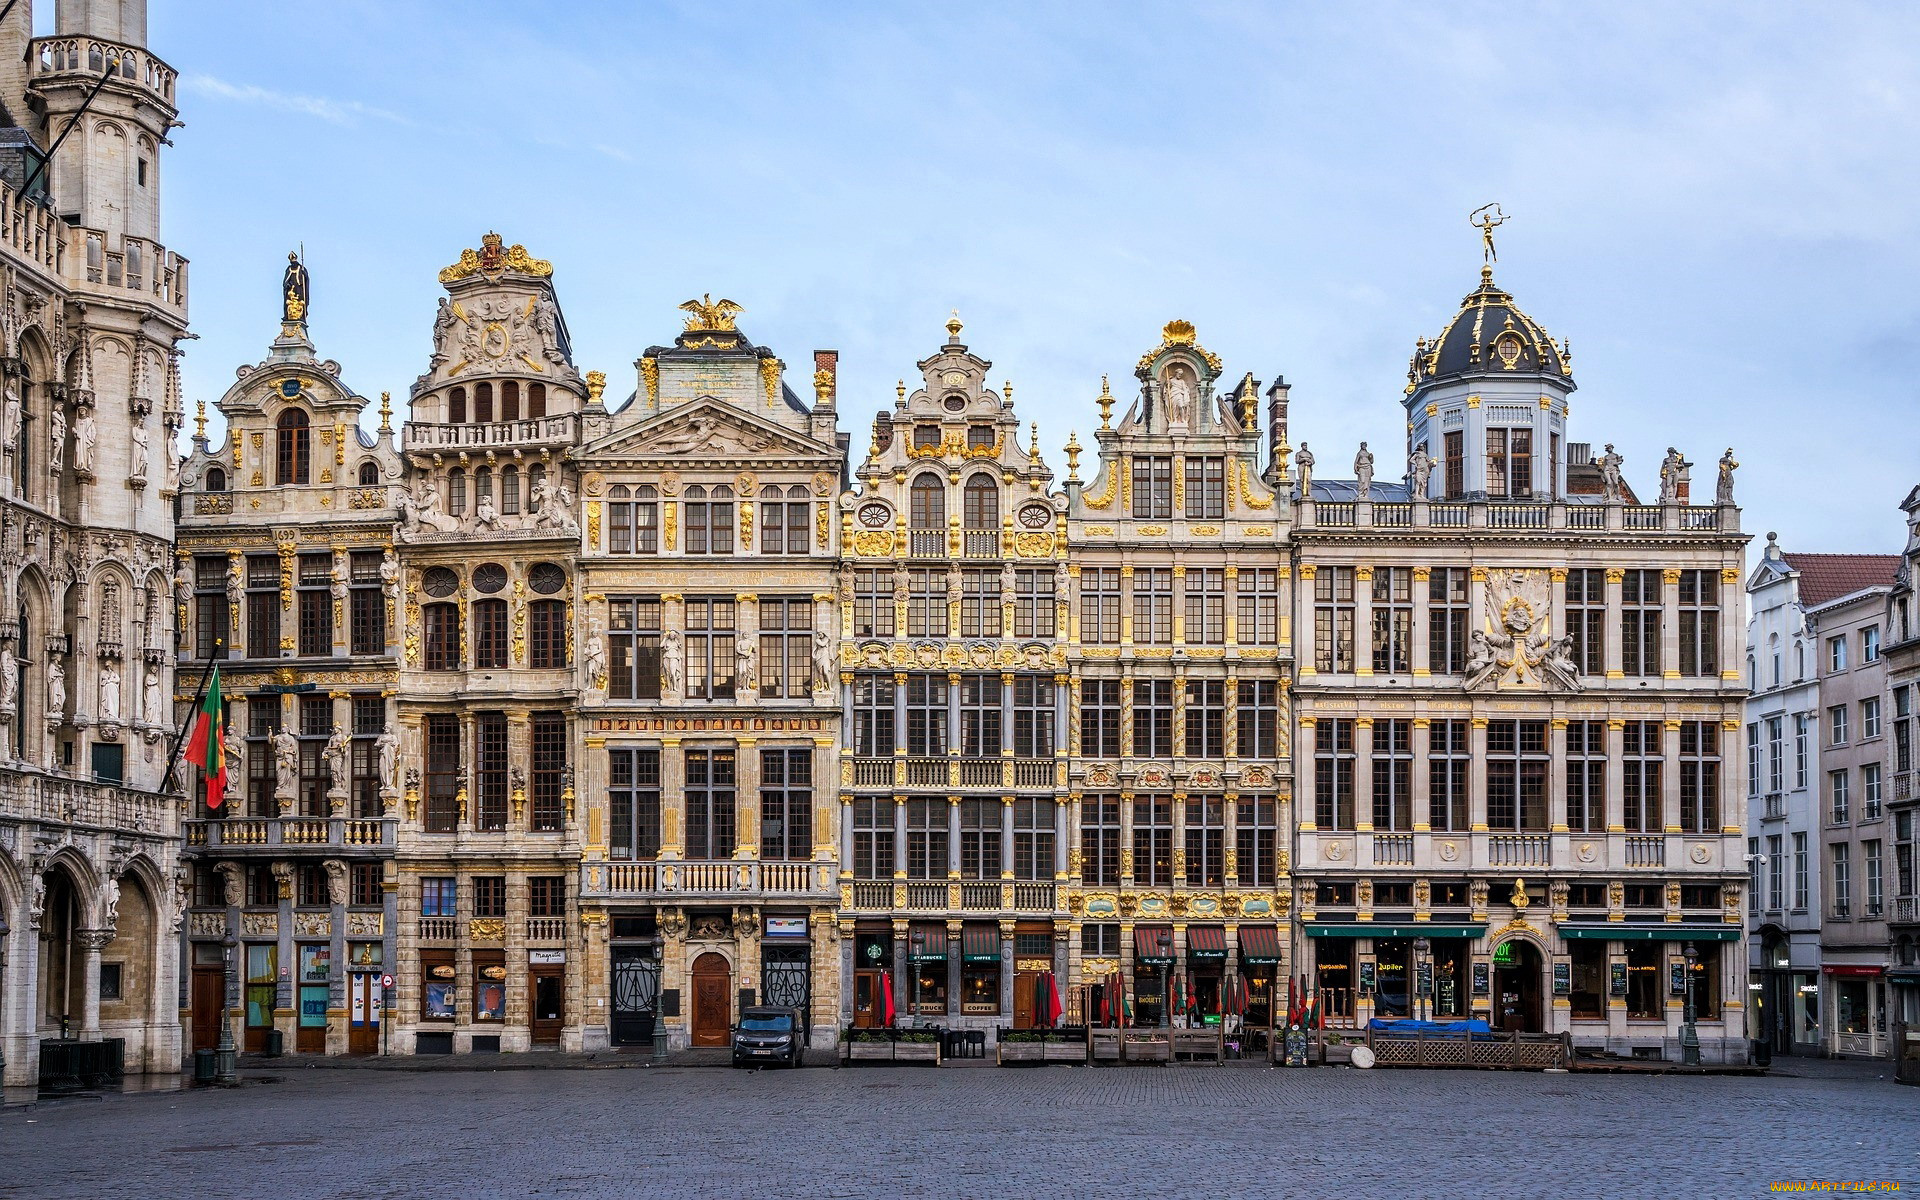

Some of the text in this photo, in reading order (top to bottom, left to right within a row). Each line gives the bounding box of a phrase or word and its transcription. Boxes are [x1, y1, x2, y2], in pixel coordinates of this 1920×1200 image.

[942, 374, 965, 385] 1697
[274, 530, 295, 541] 1699
[1378, 962, 1404, 971] Jupiler
